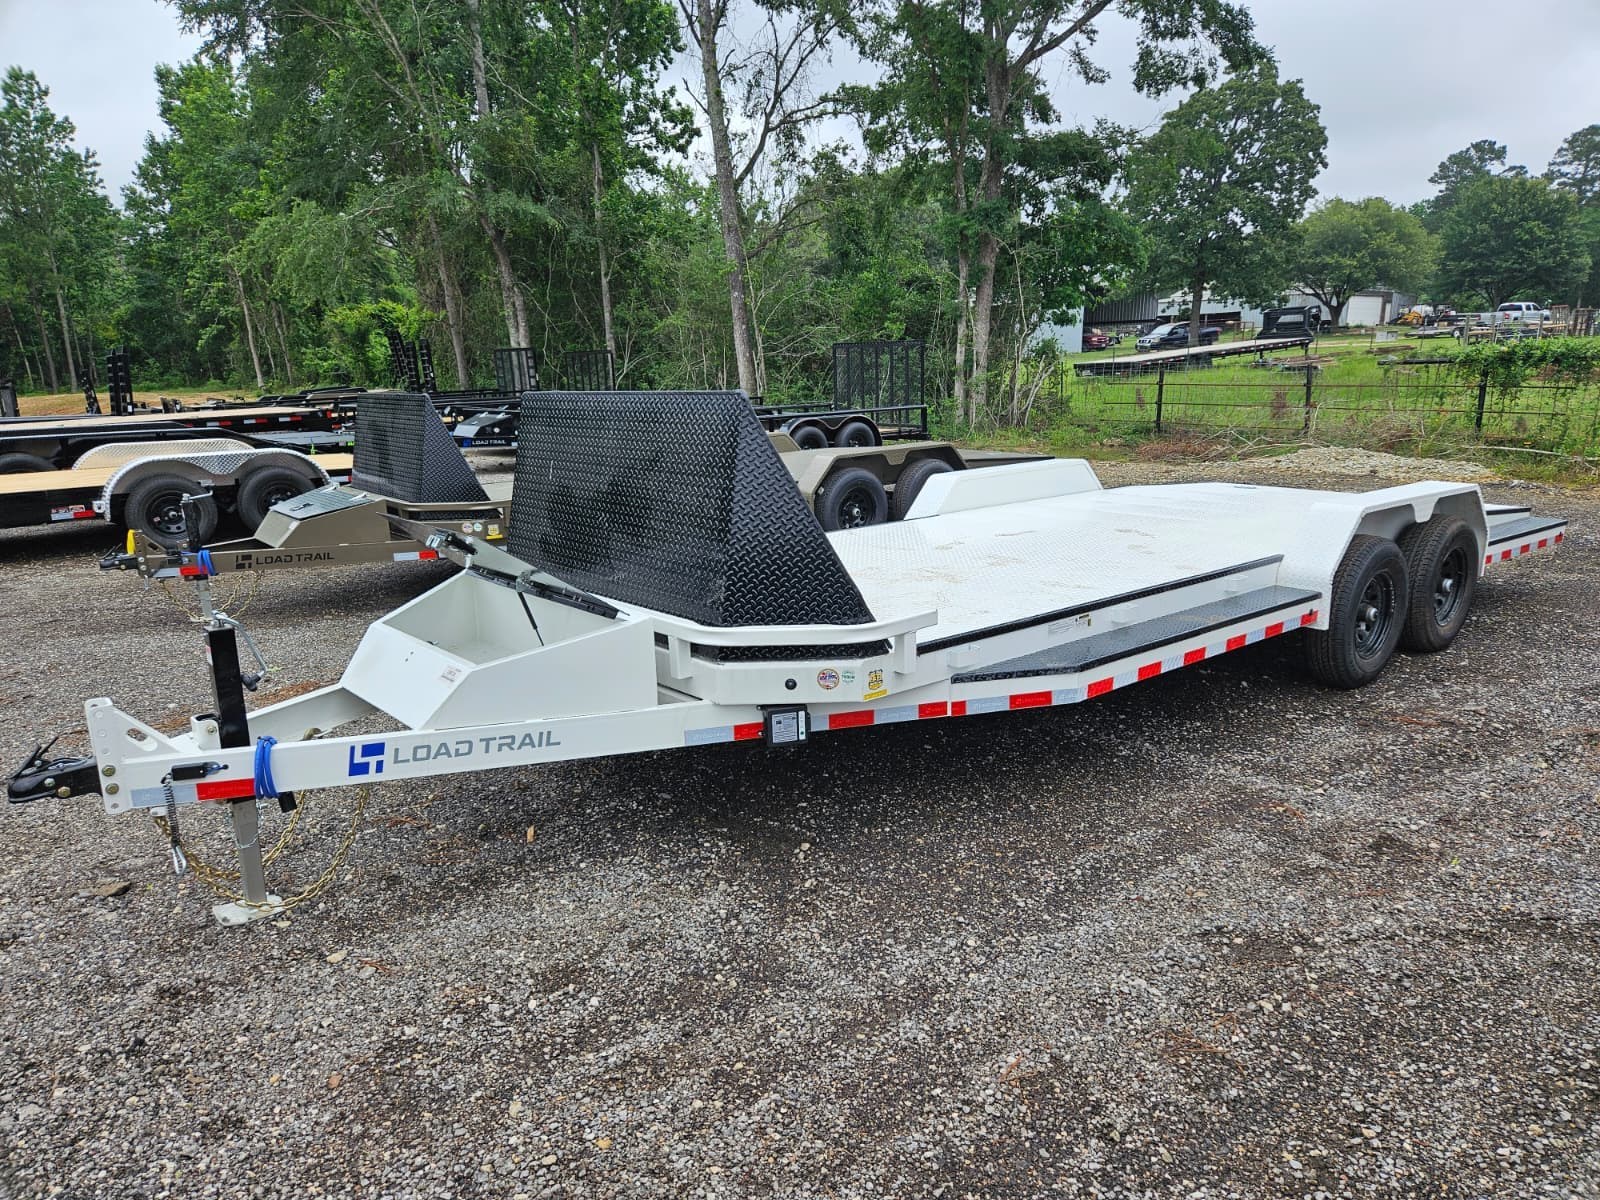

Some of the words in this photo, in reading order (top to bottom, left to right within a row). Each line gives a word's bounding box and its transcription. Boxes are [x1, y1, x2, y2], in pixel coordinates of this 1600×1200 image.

[256, 555, 293, 565] LOAD
[295, 552, 335, 562] TRAIL
[393, 739, 474, 764] LOAD
[479, 730, 561, 754] TRAIL
